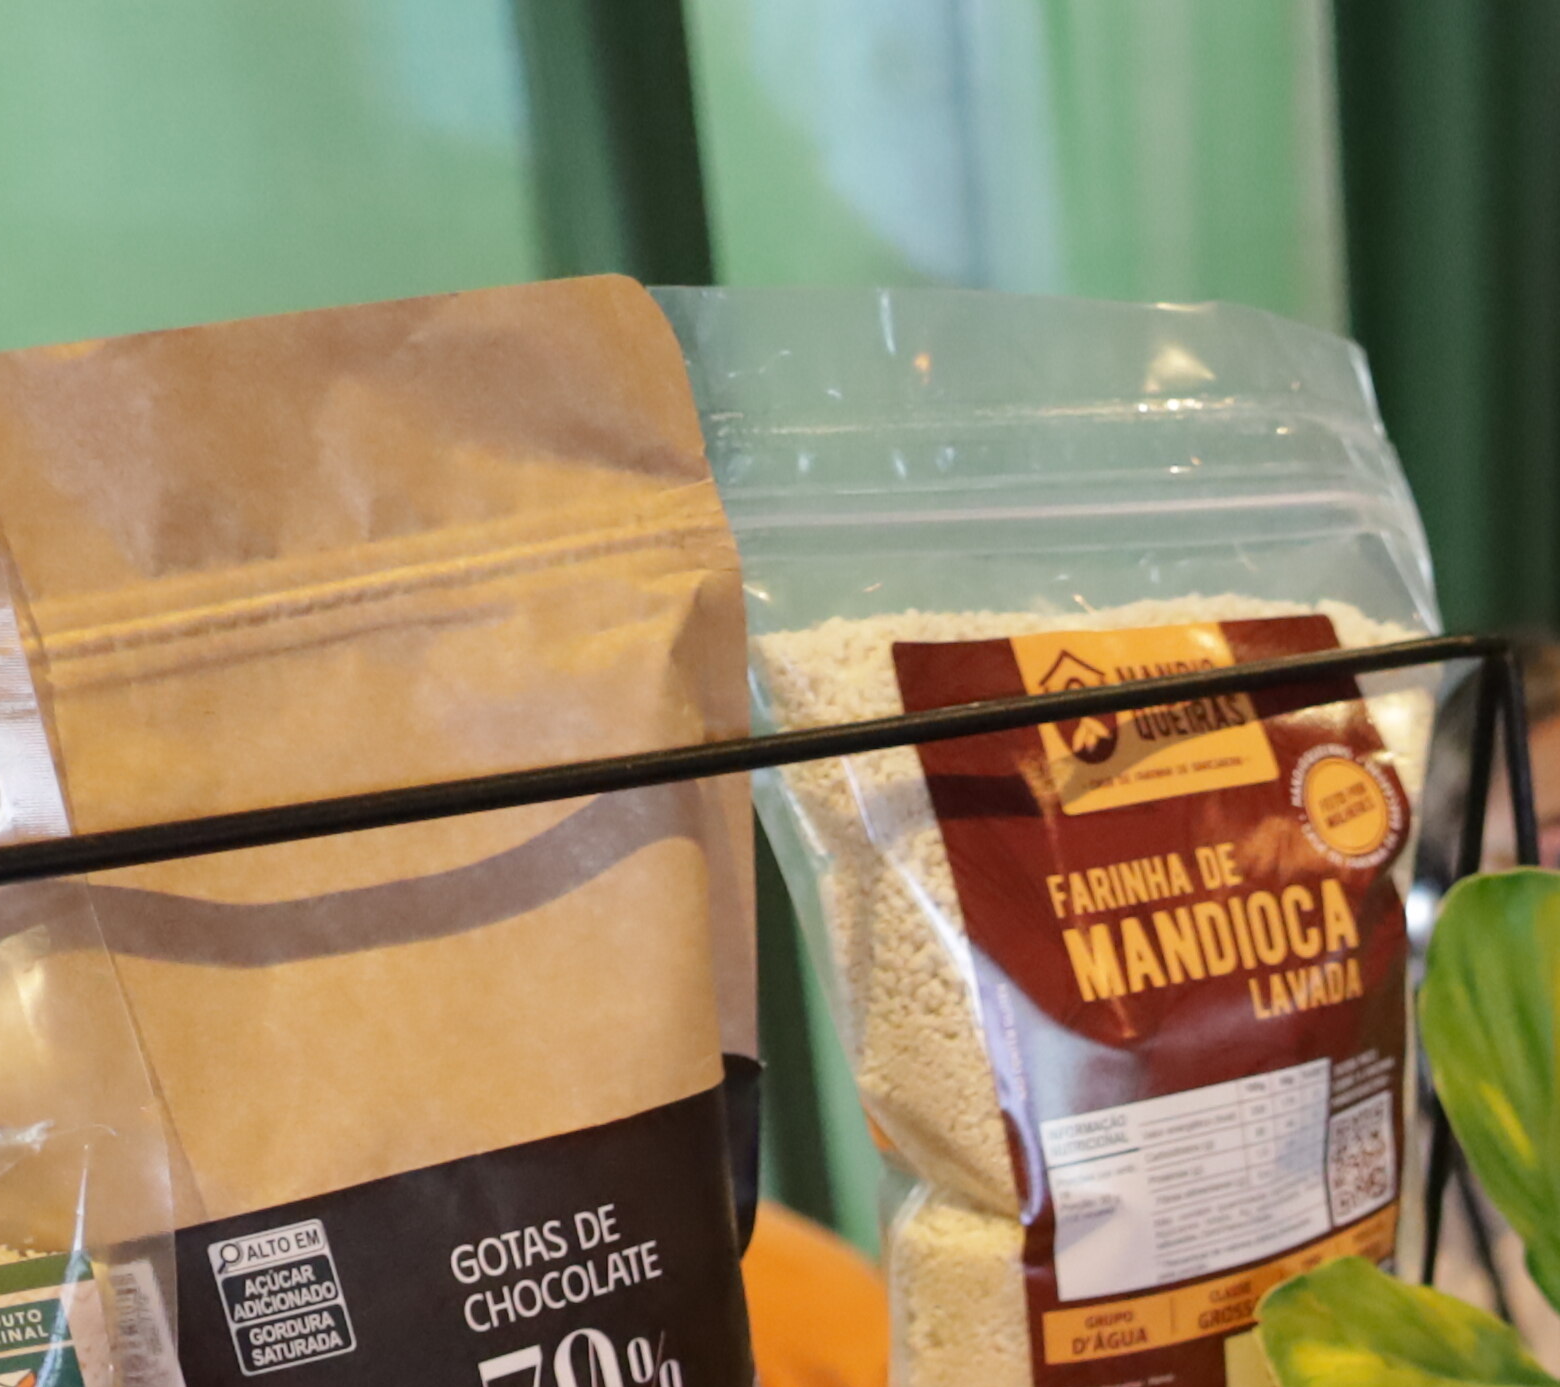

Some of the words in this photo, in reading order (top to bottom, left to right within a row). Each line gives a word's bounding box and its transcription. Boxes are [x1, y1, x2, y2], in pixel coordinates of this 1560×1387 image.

[1046, 852, 1194, 919] FARINHA
[1195, 842, 1244, 891] DE
[1062, 878, 1359, 1003] MANDIOCA
[1248, 957, 1364, 1020] LAVADA
[246, 1236, 290, 1262] ALTO
[295, 1228, 321, 1249] EM
[450, 1220, 569, 1285] GOTAS
[573, 1203, 622, 1251] DE
[233, 1280, 337, 1322] ADICIONADO
[244, 1264, 316, 1298] AÇÚCAR
[463, 1240, 663, 1333] CHOCOLATE
[249, 1310, 335, 1346] GORDURA
[251, 1331, 344, 1367] SATURADA
